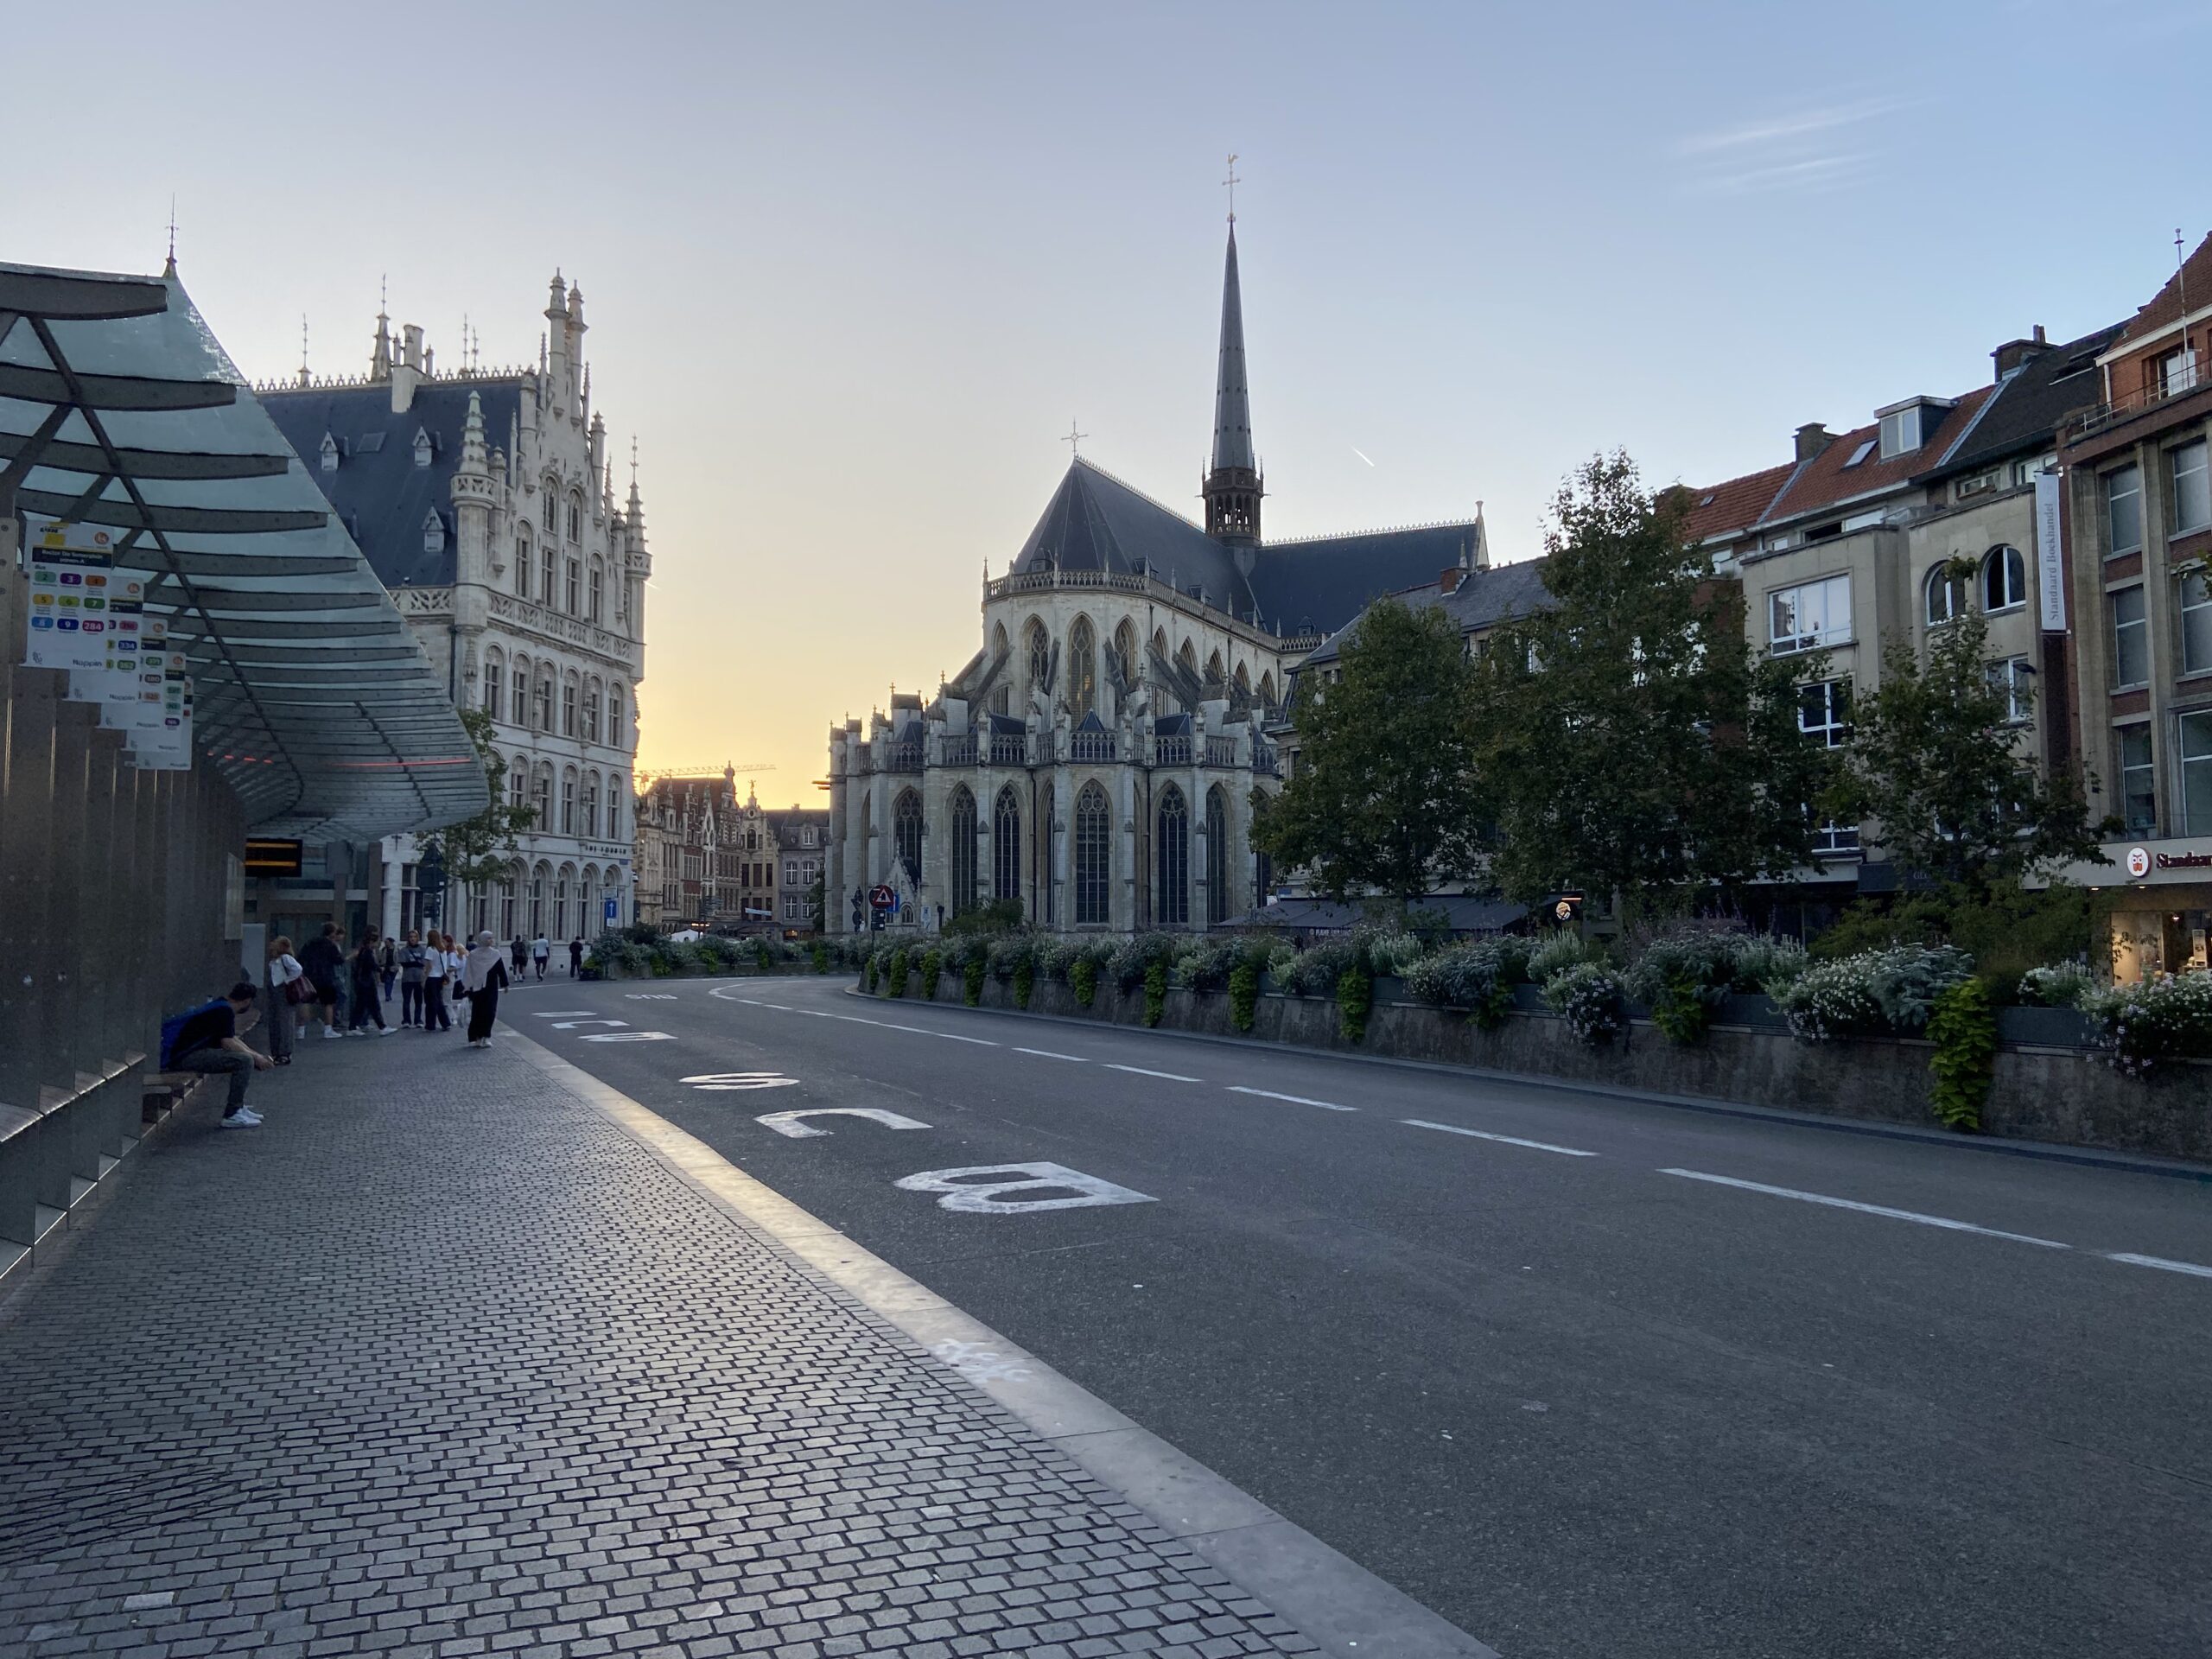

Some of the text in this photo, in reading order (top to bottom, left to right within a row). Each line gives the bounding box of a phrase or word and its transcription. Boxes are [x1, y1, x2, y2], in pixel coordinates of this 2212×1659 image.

[2044, 503, 2059, 621] Standaard Boekhandel
[84, 621, 102, 630] 284
